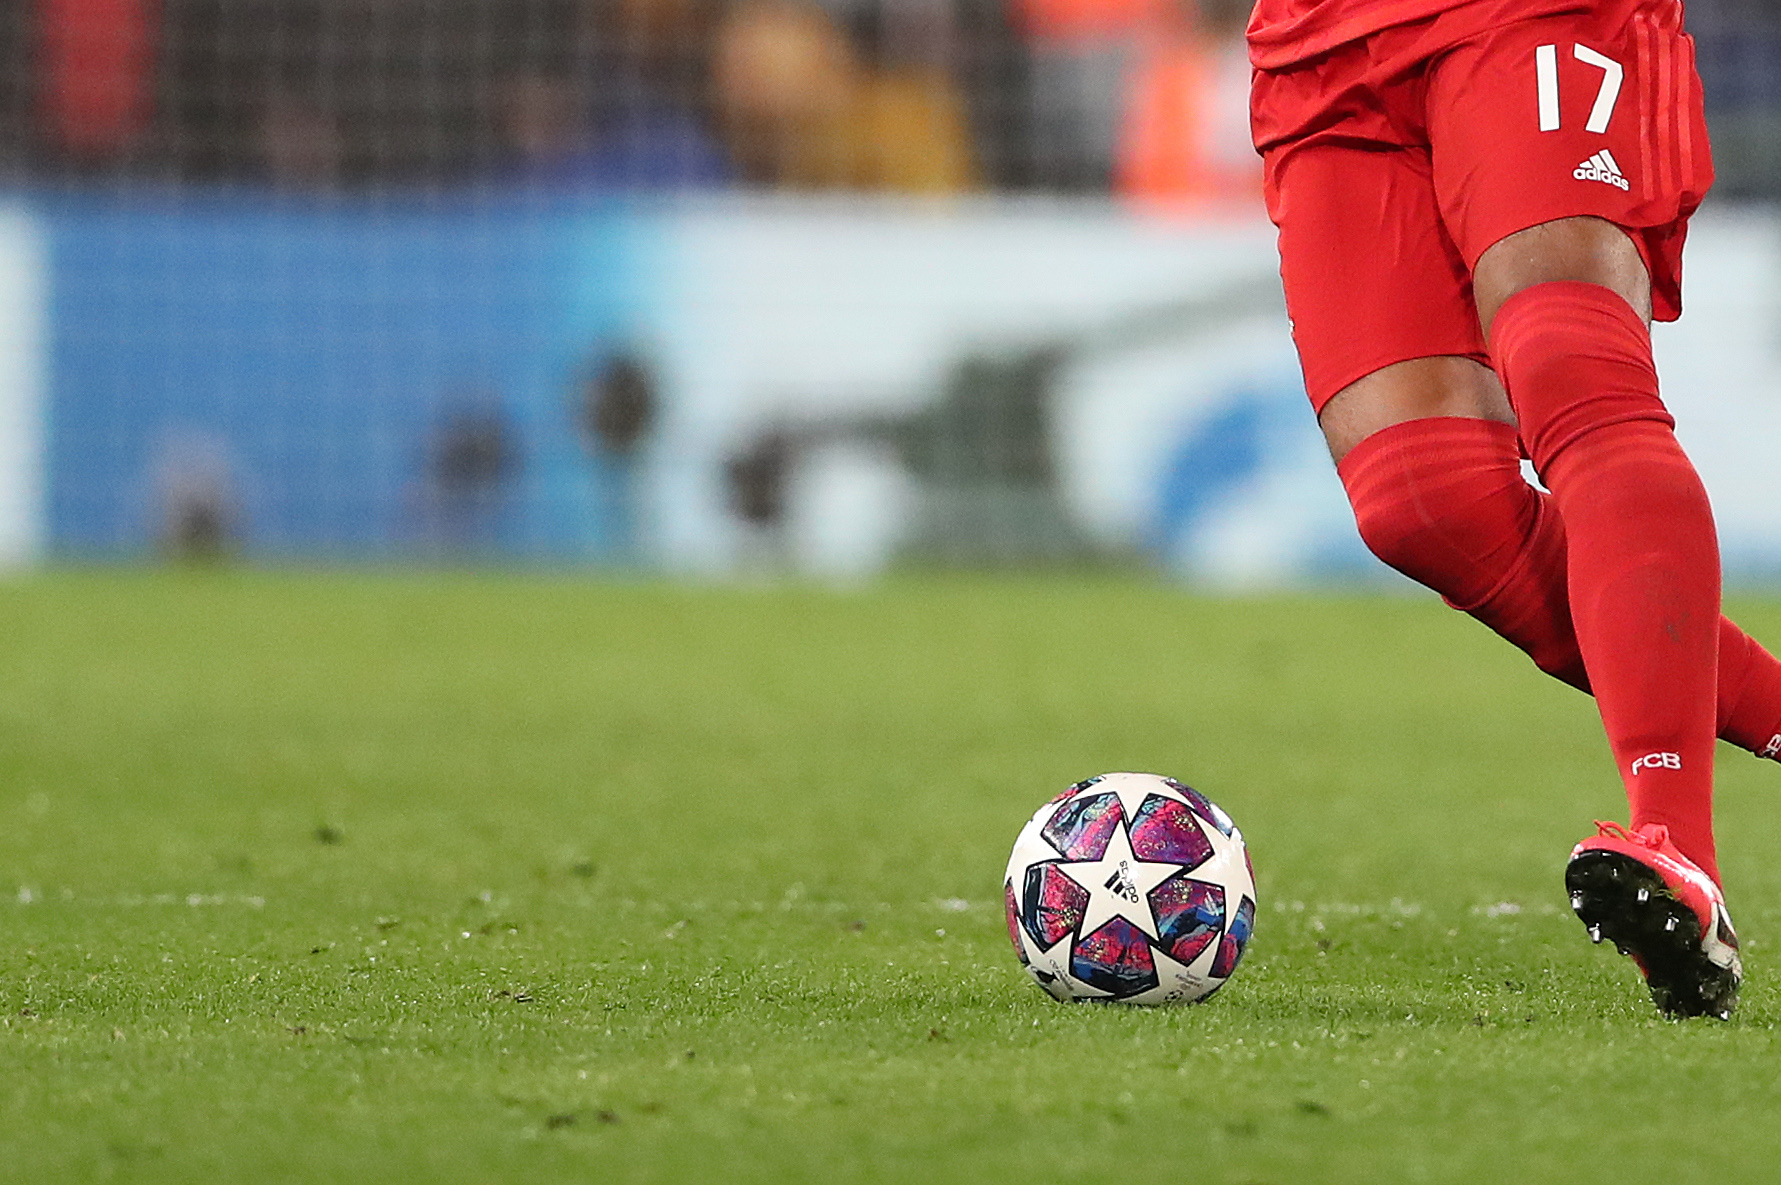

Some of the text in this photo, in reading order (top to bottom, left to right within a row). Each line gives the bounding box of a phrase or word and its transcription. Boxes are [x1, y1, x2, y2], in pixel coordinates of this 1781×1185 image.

[1536, 42, 1624, 134] 17
[1573, 166, 1630, 191] adidas
[1631, 752, 1682, 776] FCB
